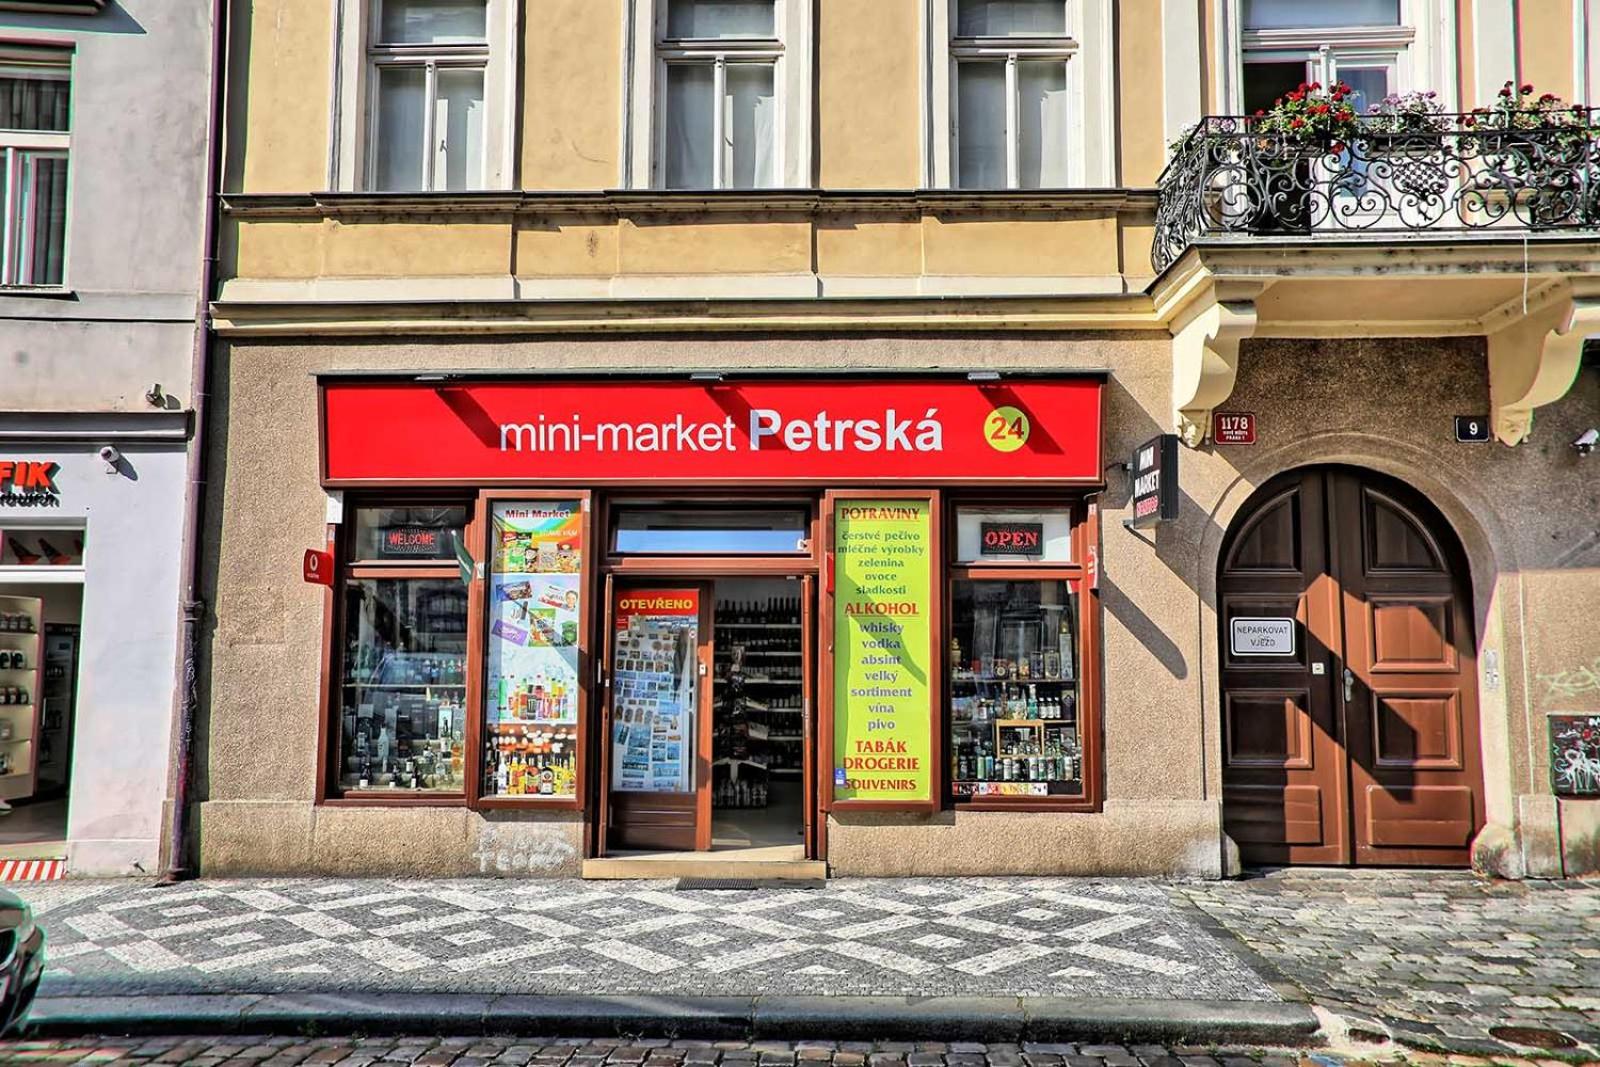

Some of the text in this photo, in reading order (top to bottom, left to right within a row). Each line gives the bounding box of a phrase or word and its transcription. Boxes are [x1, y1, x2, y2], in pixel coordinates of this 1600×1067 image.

[990, 416, 1024, 440] 24
[1221, 417, 1248, 430] 1178
[1469, 421, 1478, 435] 9
[500, 409, 943, 452] mini-market Petrská
[1134, 469, 1160, 498] MARKET
[505, 509, 570, 518] Mini Market
[841, 507, 920, 520] POTRAVINY
[389, 531, 435, 545] WELCOME
[842, 530, 920, 542] čerstvé pečivo
[985, 531, 1038, 546] OPEN
[838, 544, 924, 556] mléčné výrobky
[858, 558, 904, 567] zelenina
[864, 573, 897, 581] ovoce
[856, 585, 906, 595] sladkosti
[619, 597, 693, 609] OTEVŘENO
[844, 602, 919, 615] ALKOHOL
[860, 622, 903, 635] whisky
[1236, 626, 1288, 634] NEPARKOVAT
[862, 638, 900, 648] vodka
[1250, 638, 1276, 647] VJEZD
[861, 654, 902, 665] absint
[865, 670, 898, 683] velký
[851, 686, 912, 697] sortiment
[868, 702, 895, 713] vína
[868, 718, 895, 731] pivo
[855, 737, 907, 752] TABÁK
[843, 757, 920, 770] DROGERIE
[844, 779, 917, 790] SOUVENIRS
